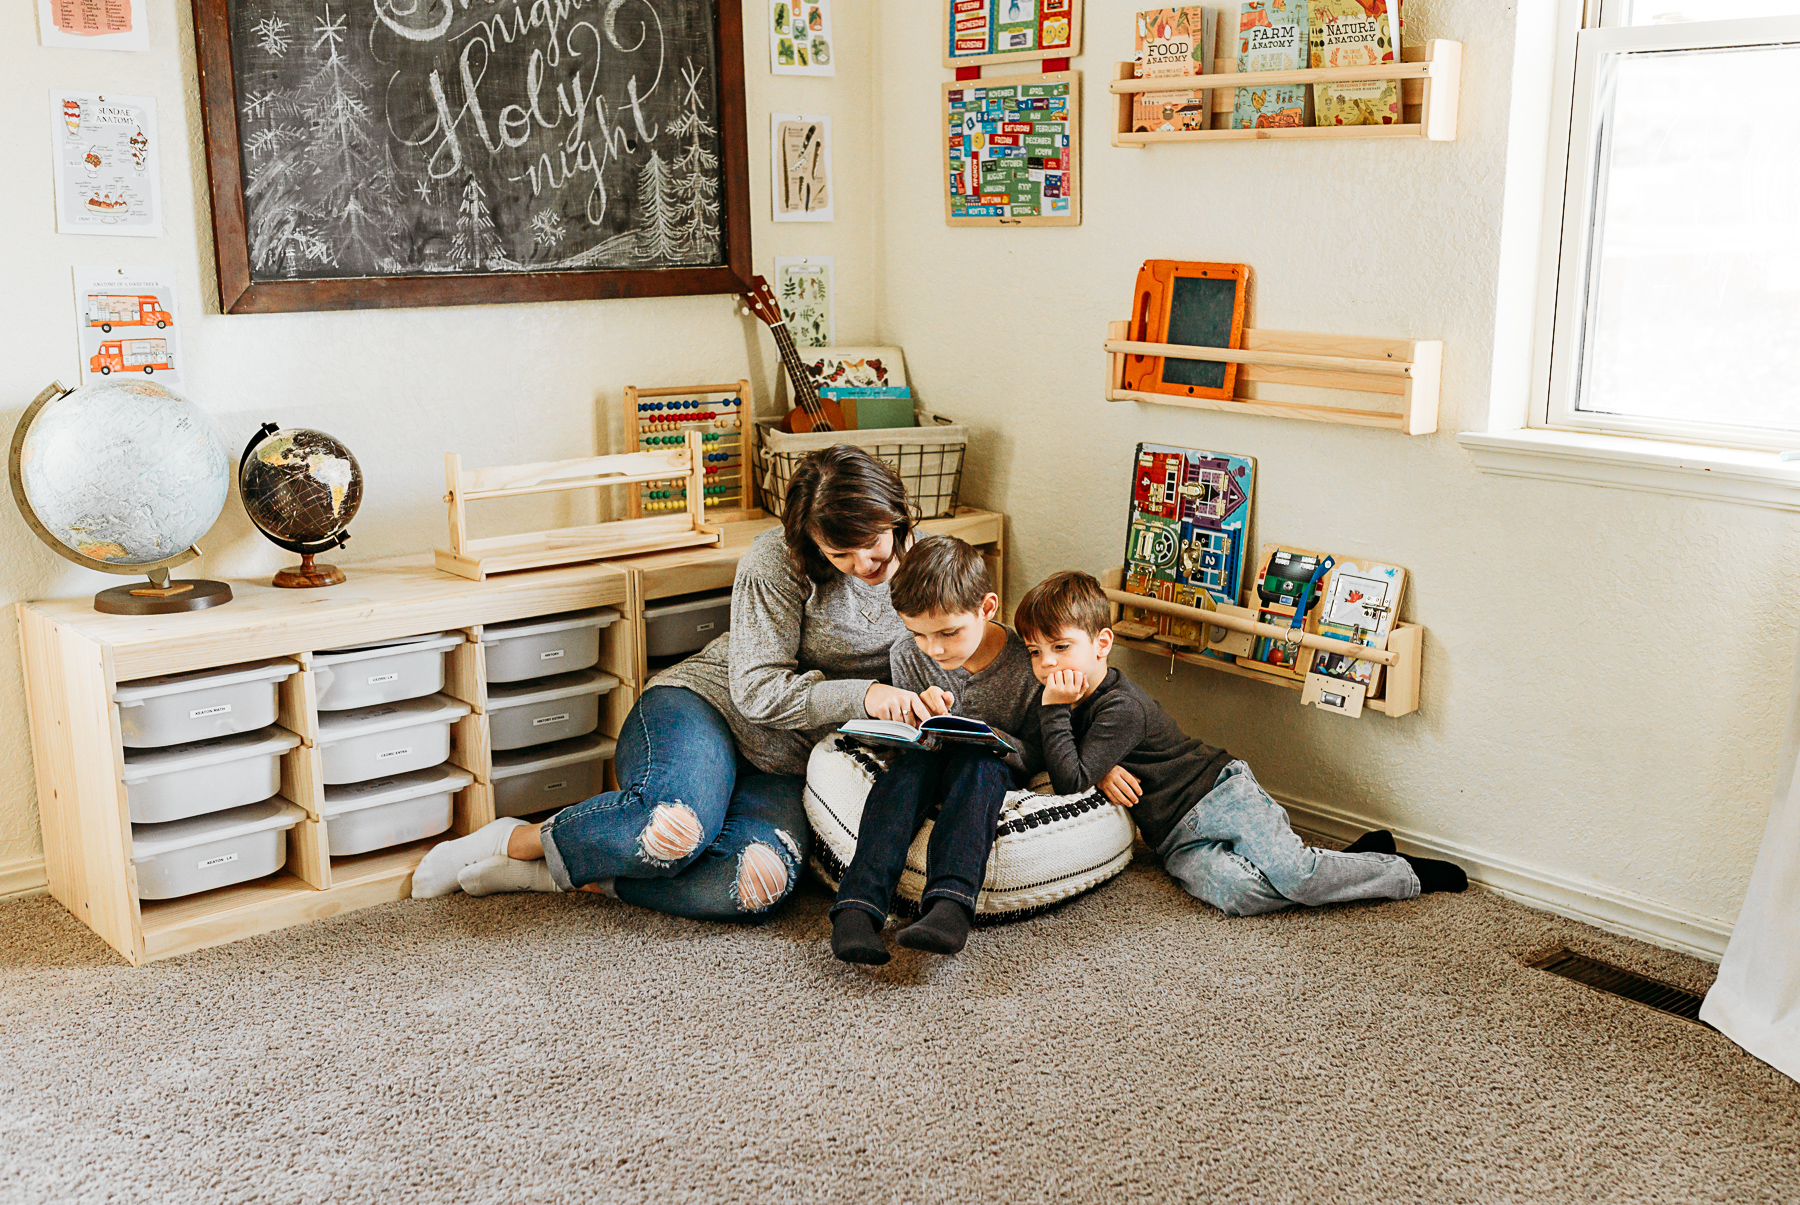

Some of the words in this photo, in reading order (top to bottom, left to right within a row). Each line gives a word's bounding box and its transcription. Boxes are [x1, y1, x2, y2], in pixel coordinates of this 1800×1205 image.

[957, 1, 980, 11] TUESDAY
[957, 18, 985, 30] WEDNESDAY
[1326, 21, 1376, 36] NATURE
[1252, 26, 1295, 41] FARM
[1327, 34, 1376, 45] ANATOMY
[957, 40, 983, 49] THURSDAY
[1251, 39, 1294, 50] ANATOMY
[1147, 42, 1189, 57] FOOD
[1146, 54, 1188, 64] ANATOMY
[988, 88, 1015, 98] NOVEMBER
[1028, 87, 1044, 96] APRIL
[386, 22, 601, 178] Holy
[98, 107, 131, 116] SUNDAE
[1030, 112, 1041, 120] MAY
[96, 115, 134, 125] ANATOMY
[1004, 124, 1031, 133] SATURDAY
[1035, 124, 1062, 133] FEBRUARY
[994, 136, 1013, 144] FRIDAY
[1025, 136, 1051, 145] DECEMBER
[508, 65, 662, 225] night
[1035, 148, 1053, 156] MARCH
[1000, 159, 1023, 167] OCTOBER
[986, 171, 1007, 181] AUGUST
[983, 185, 1006, 193] JANUARY
[1018, 183, 1032, 191] JULY
[981, 196, 1002, 204] AUTUMN
[1018, 194, 1032, 202] JUNE
[968, 207, 988, 215] WINTER
[1012, 206, 1032, 215] SPRING
[1141, 476, 1151, 486] 4
[1155, 543, 1164, 551] 5
[1205, 555, 1216, 566] 2
